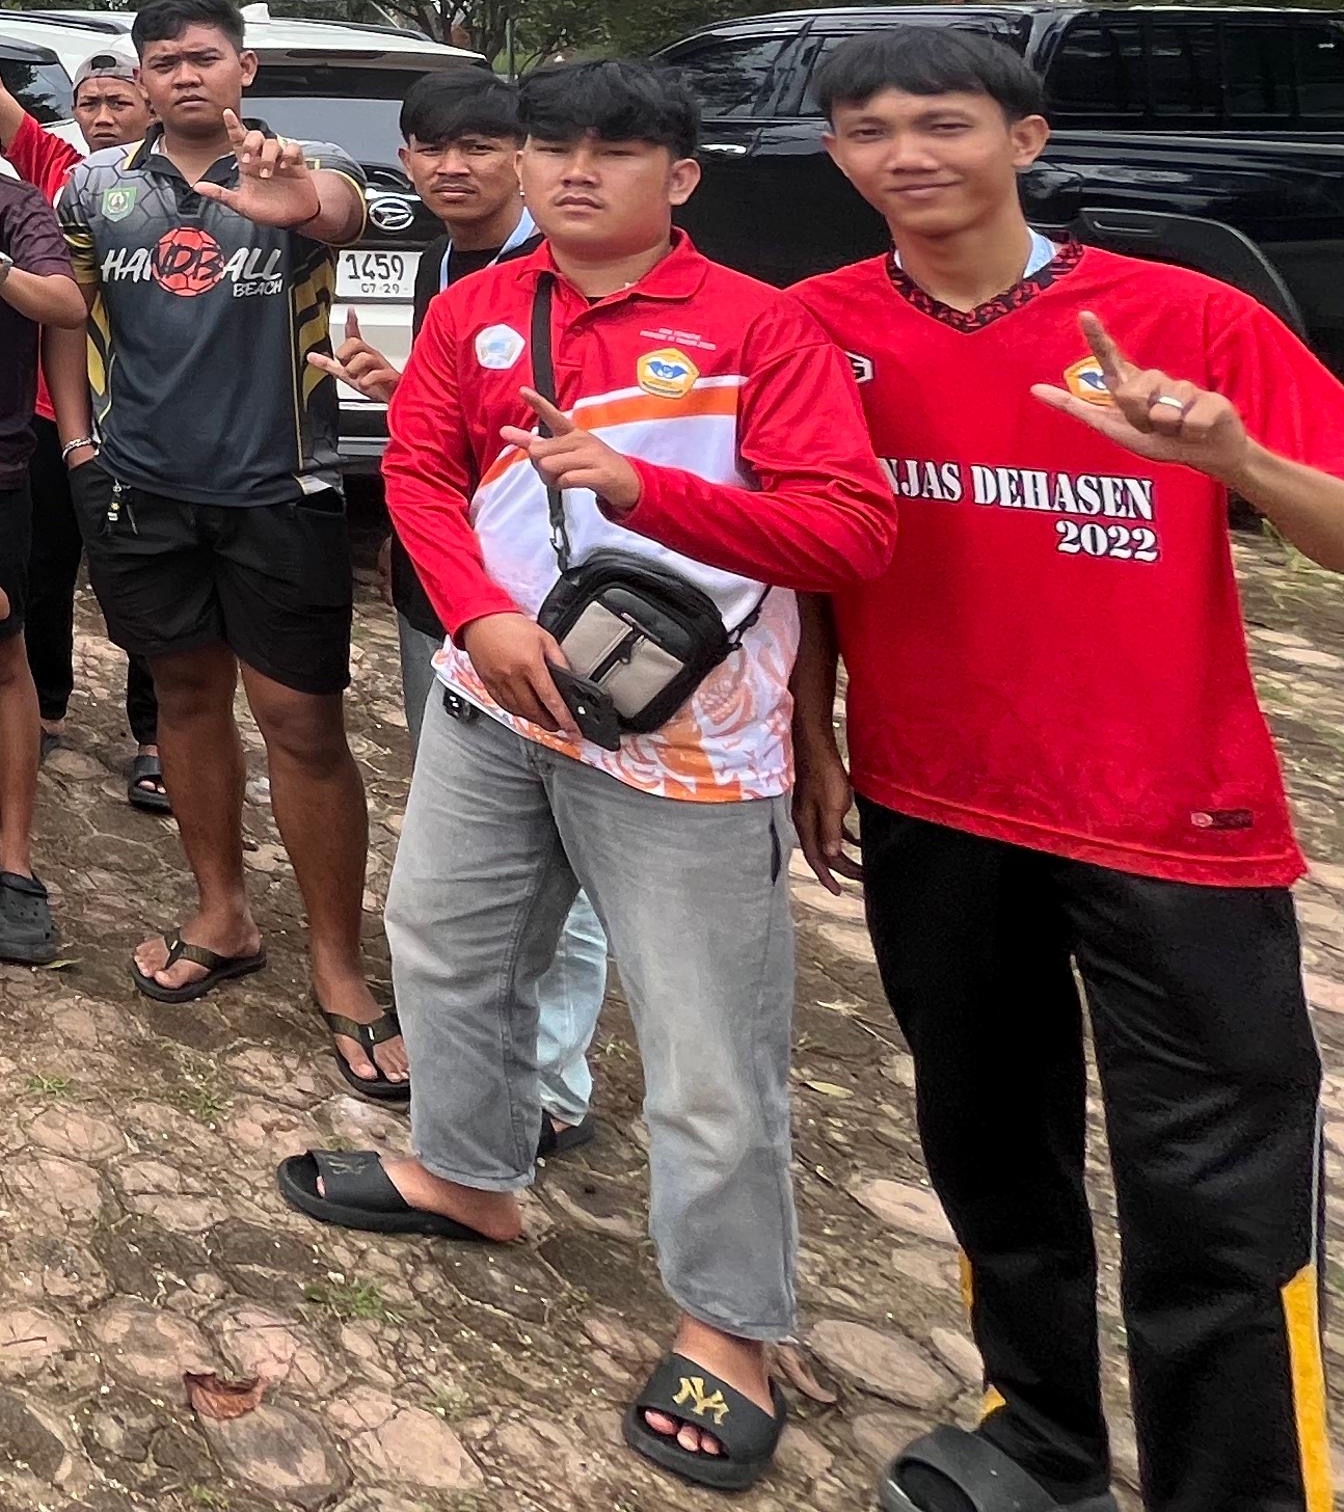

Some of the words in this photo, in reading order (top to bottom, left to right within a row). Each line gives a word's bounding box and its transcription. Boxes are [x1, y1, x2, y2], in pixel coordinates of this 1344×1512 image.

[100, 244, 283, 283] HANDBALL
[345, 253, 404, 281] 1459
[232, 278, 283, 298] BEACH
[970, 464, 1154, 521] DEHASEN
[1055, 519, 1160, 562] 2022
